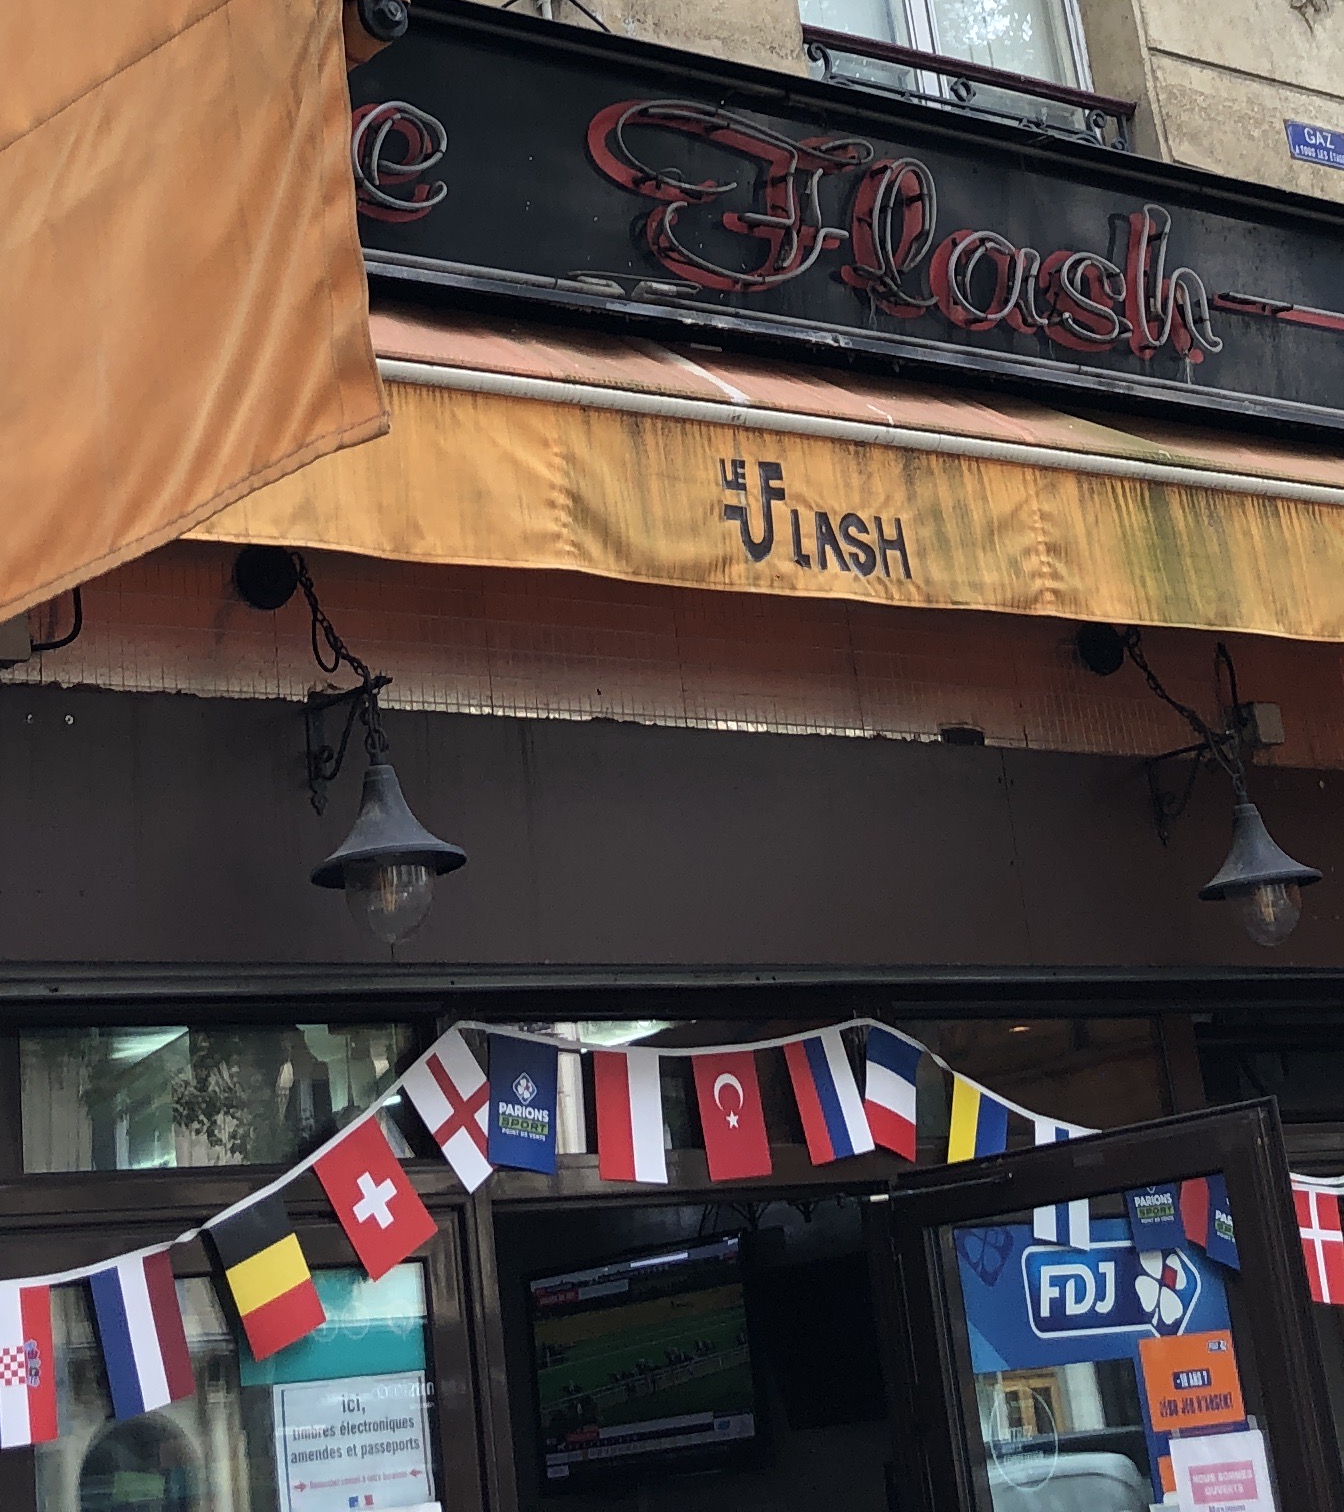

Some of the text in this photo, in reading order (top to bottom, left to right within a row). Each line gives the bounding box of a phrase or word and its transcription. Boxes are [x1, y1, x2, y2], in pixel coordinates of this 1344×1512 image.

[1304, 127, 1335, 149] GAZ
[586, 98, 1223, 363] Flash
[719, 457, 912, 580] LE FLASH
[499, 1101, 549, 1123] PARIONS
[501, 1116, 547, 1133] SPORT
[1134, 1193, 1173, 1207] PARIONS
[1037, 1261, 1117, 1319] FDJ
[342, 1394, 366, 1415] ici,
[292, 1415, 415, 1442] timbres électroniques
[290, 1437, 420, 1464] amendes et passeports
